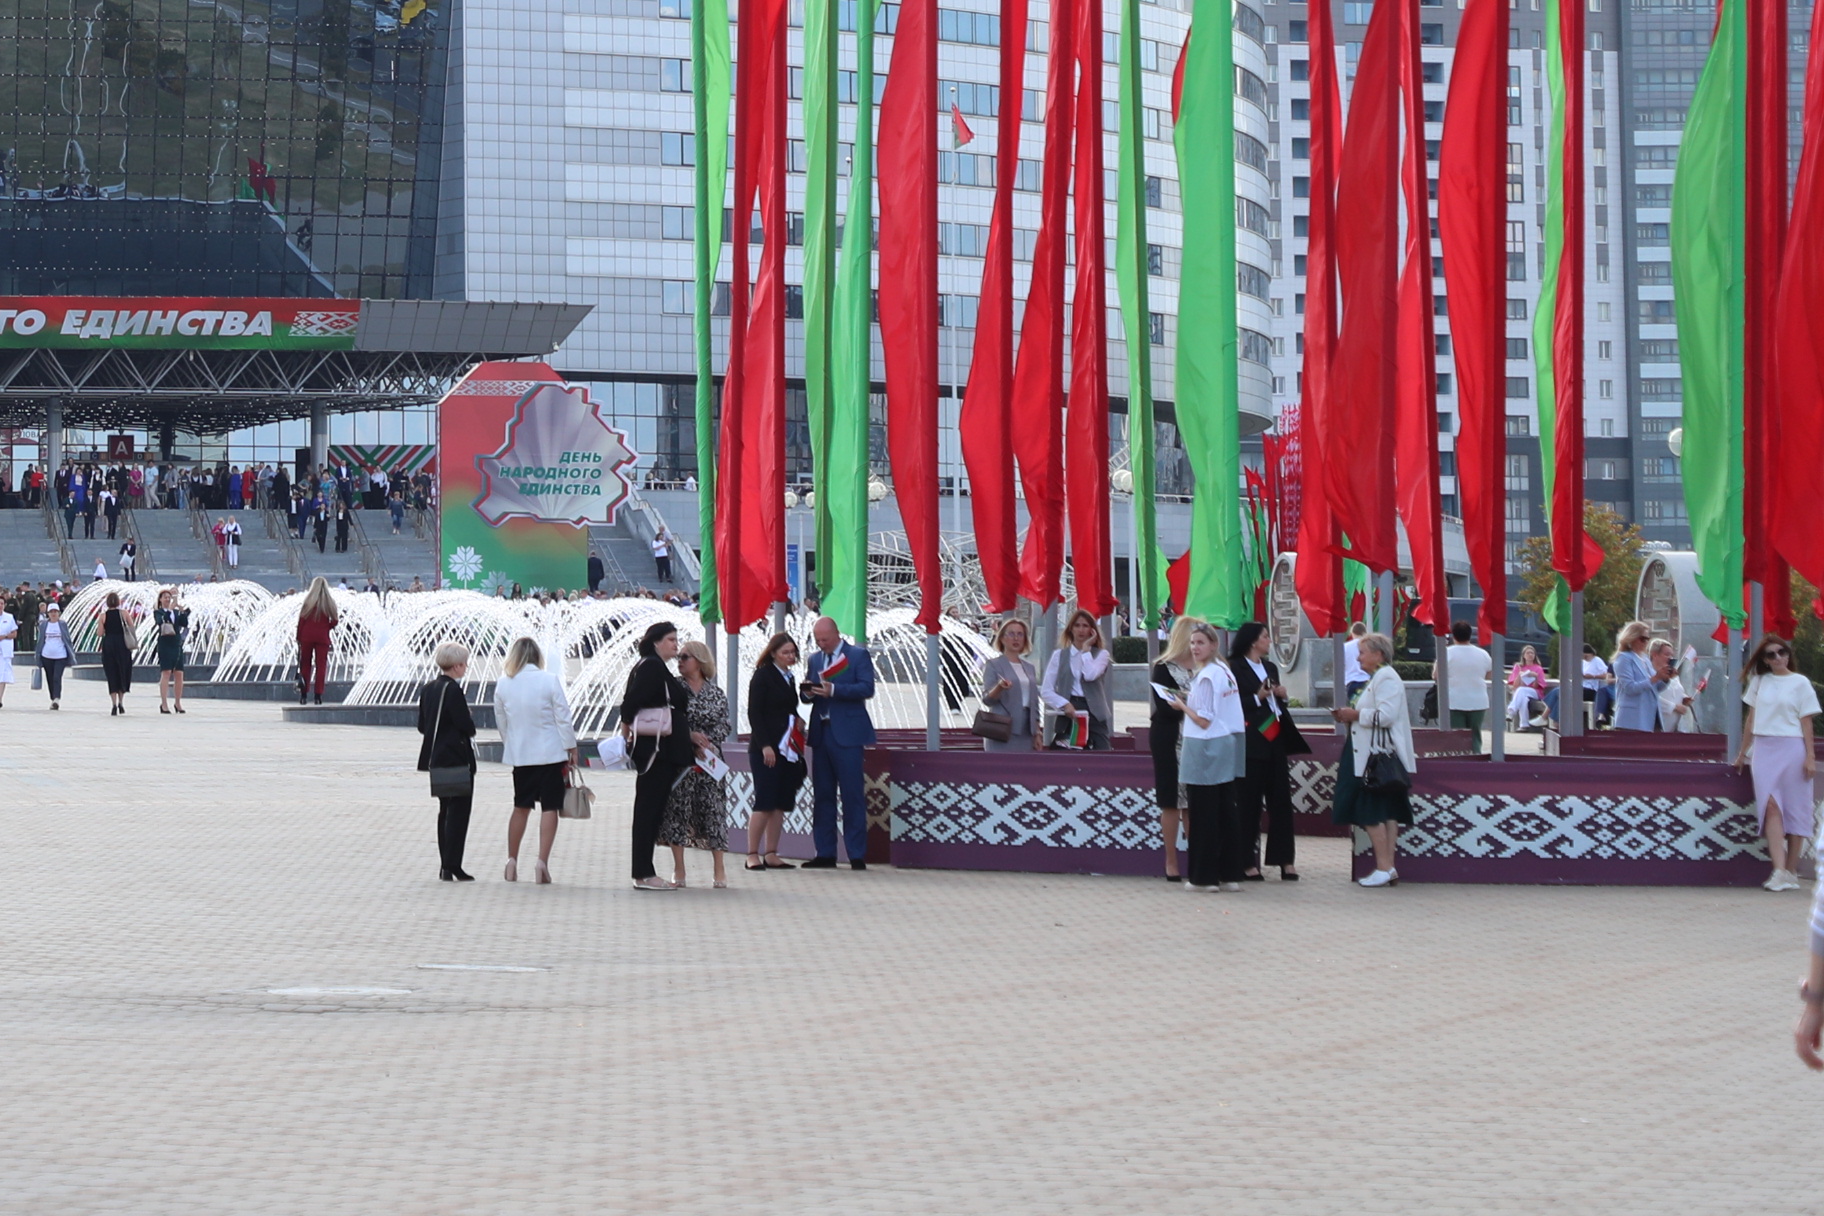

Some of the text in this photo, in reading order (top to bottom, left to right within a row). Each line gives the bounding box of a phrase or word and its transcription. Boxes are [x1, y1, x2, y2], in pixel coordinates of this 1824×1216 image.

[59, 308, 273, 340] ЕДИНСТВА
[114, 440, 128, 456] A
[558, 451, 602, 464] ДЕНЬ
[499, 466, 602, 480] НАРОДНОГО
[518, 482, 602, 496] ЕДИНСТВА
